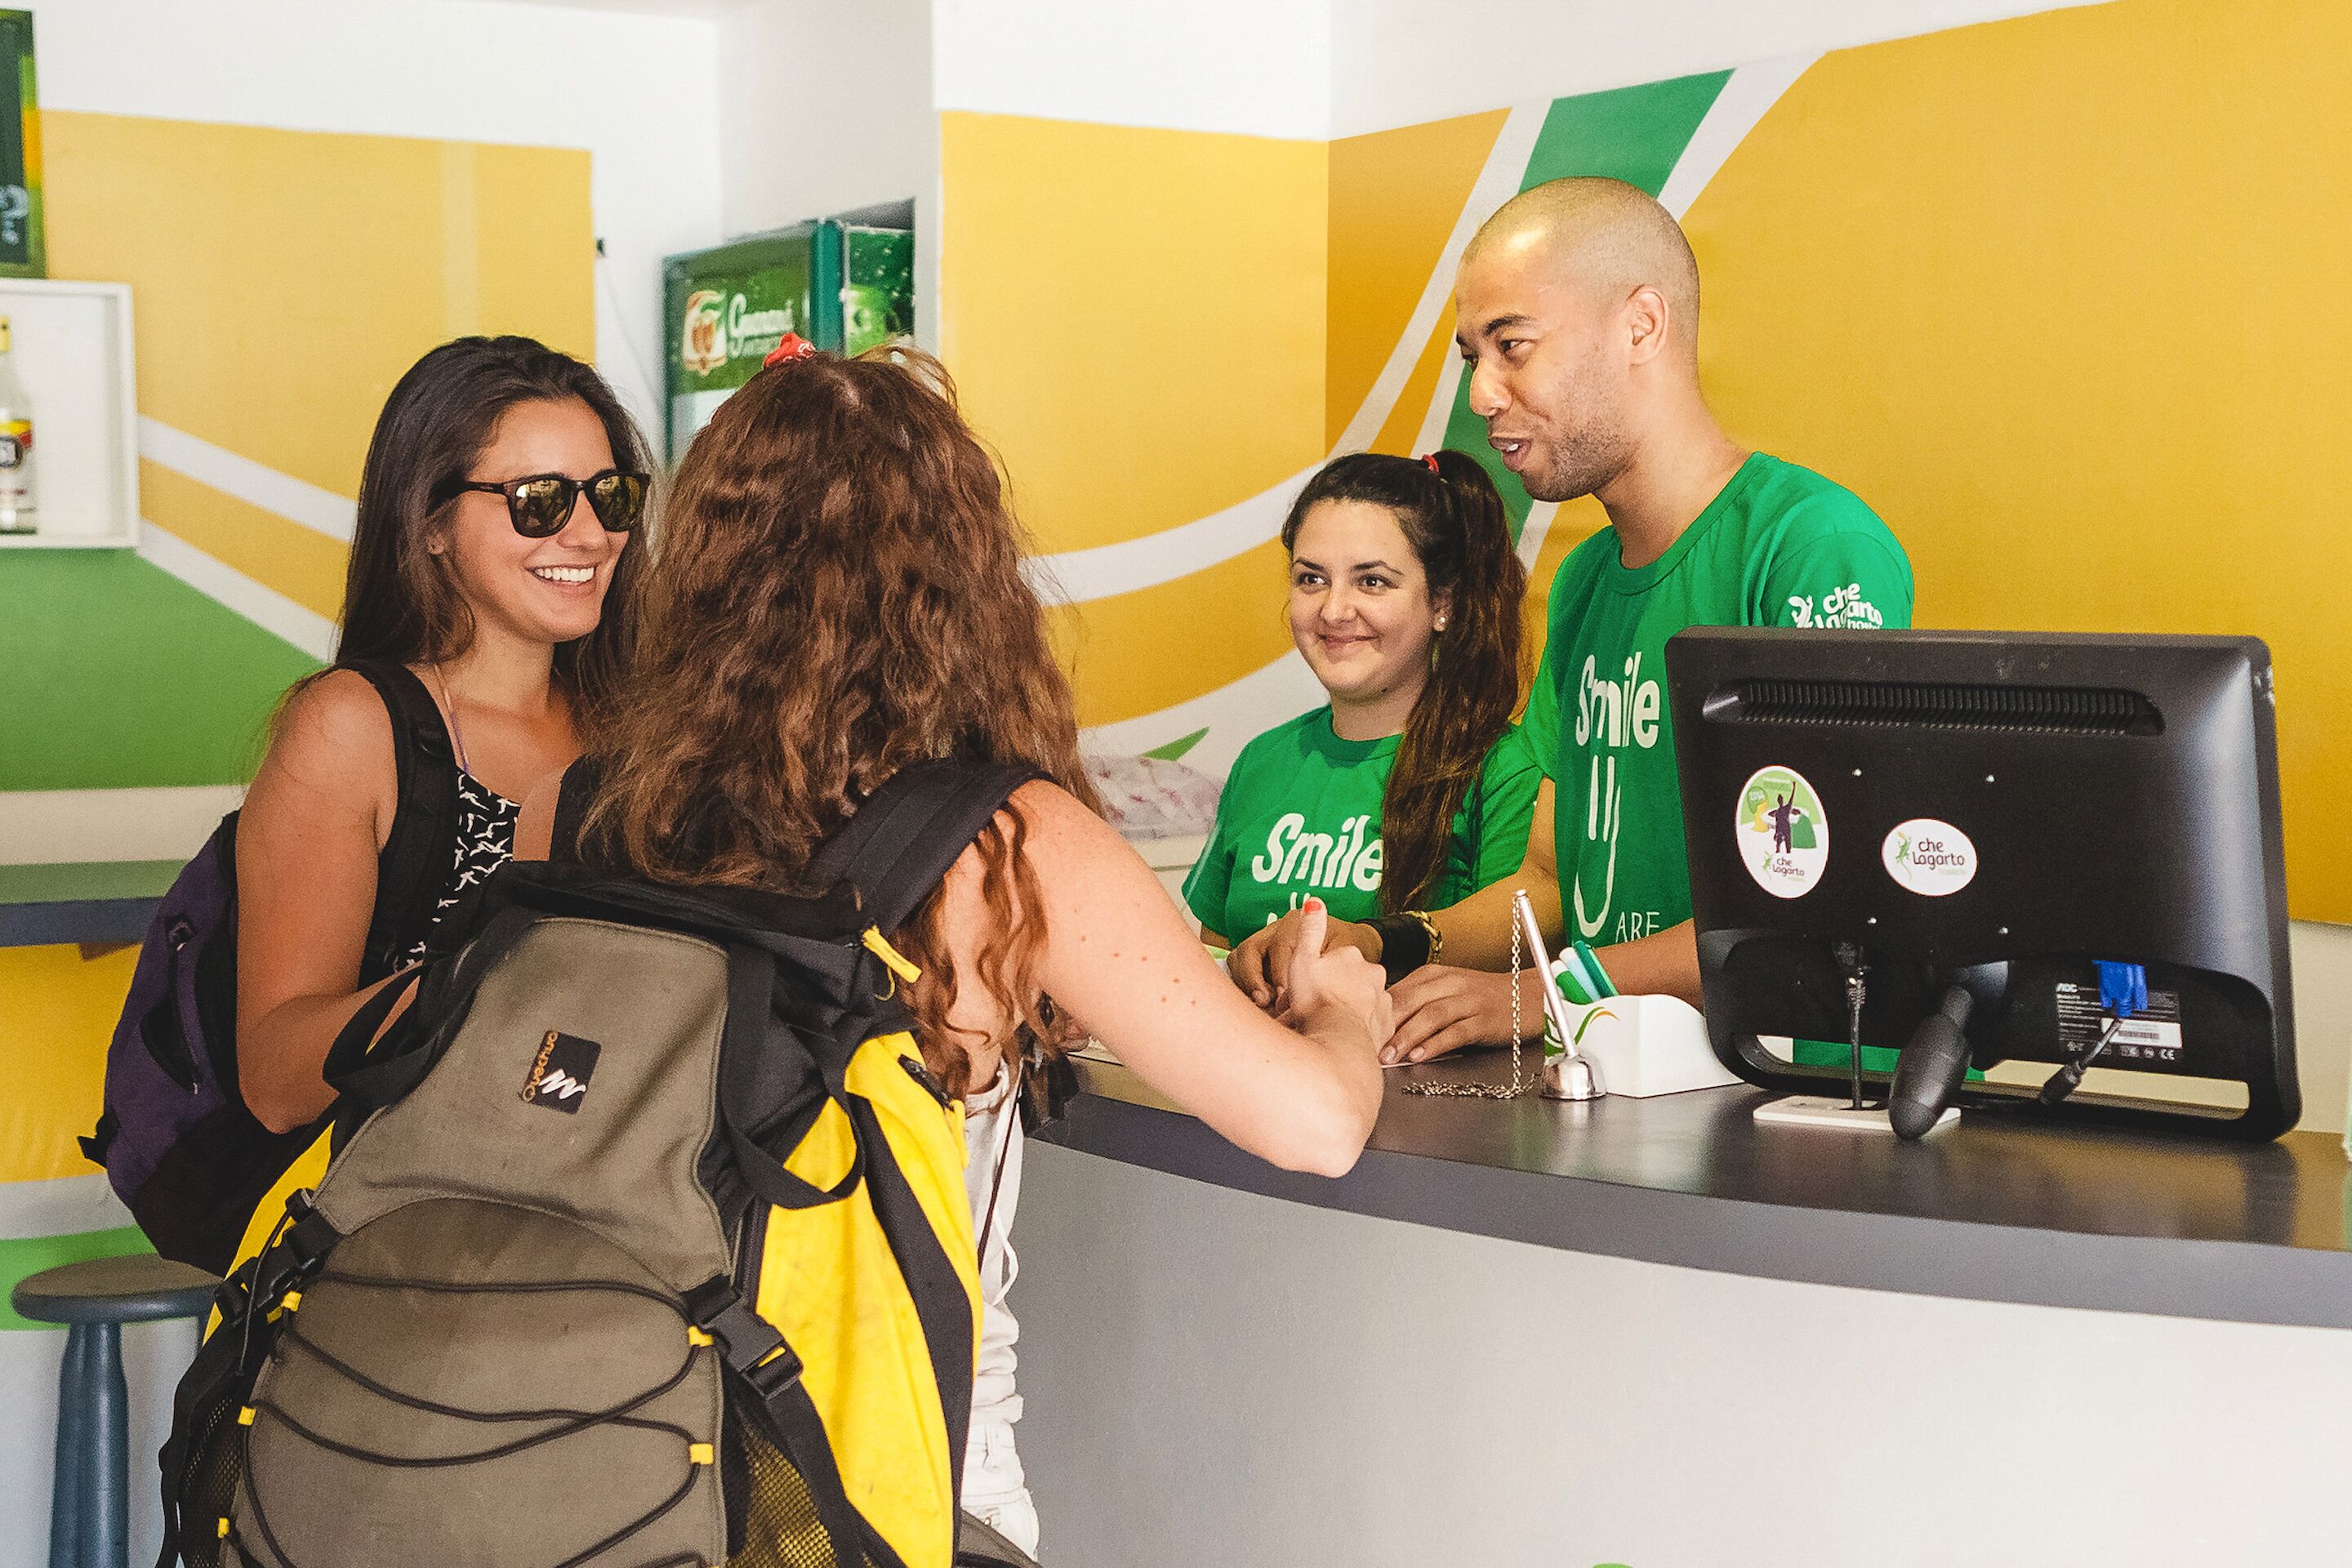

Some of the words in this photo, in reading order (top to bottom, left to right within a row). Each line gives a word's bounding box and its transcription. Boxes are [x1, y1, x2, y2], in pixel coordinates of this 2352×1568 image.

[1823, 583, 1860, 614] che
[1575, 652, 1660, 748] Smile
[1252, 813, 1384, 891] Smile
[1918, 837, 1944, 852] che
[1777, 857, 1793, 867] che
[1912, 851, 1965, 871] Lagarto
